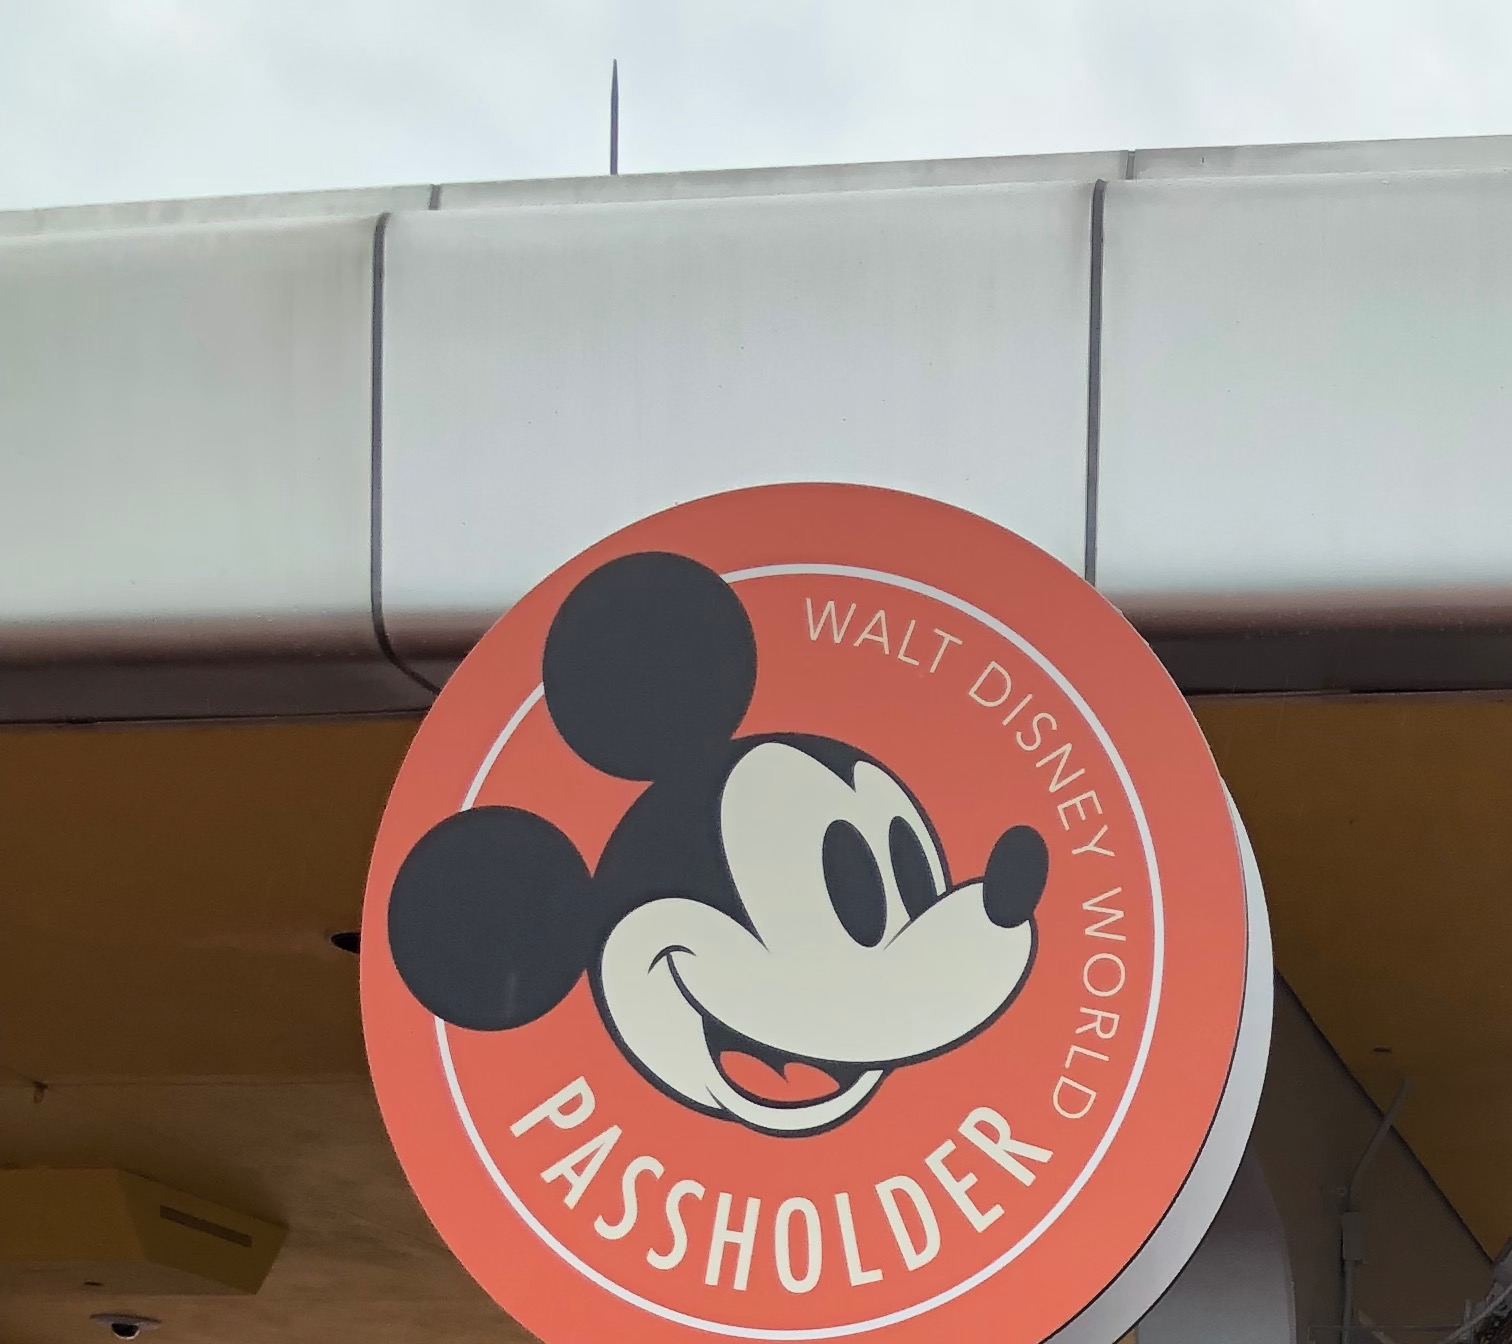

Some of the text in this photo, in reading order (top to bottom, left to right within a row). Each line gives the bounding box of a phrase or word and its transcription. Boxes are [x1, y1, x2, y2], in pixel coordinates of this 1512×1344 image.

[805, 597, 1127, 1120] WALT DISNEY WORLD
[509, 1074, 1055, 1294] PASSHOLDER
